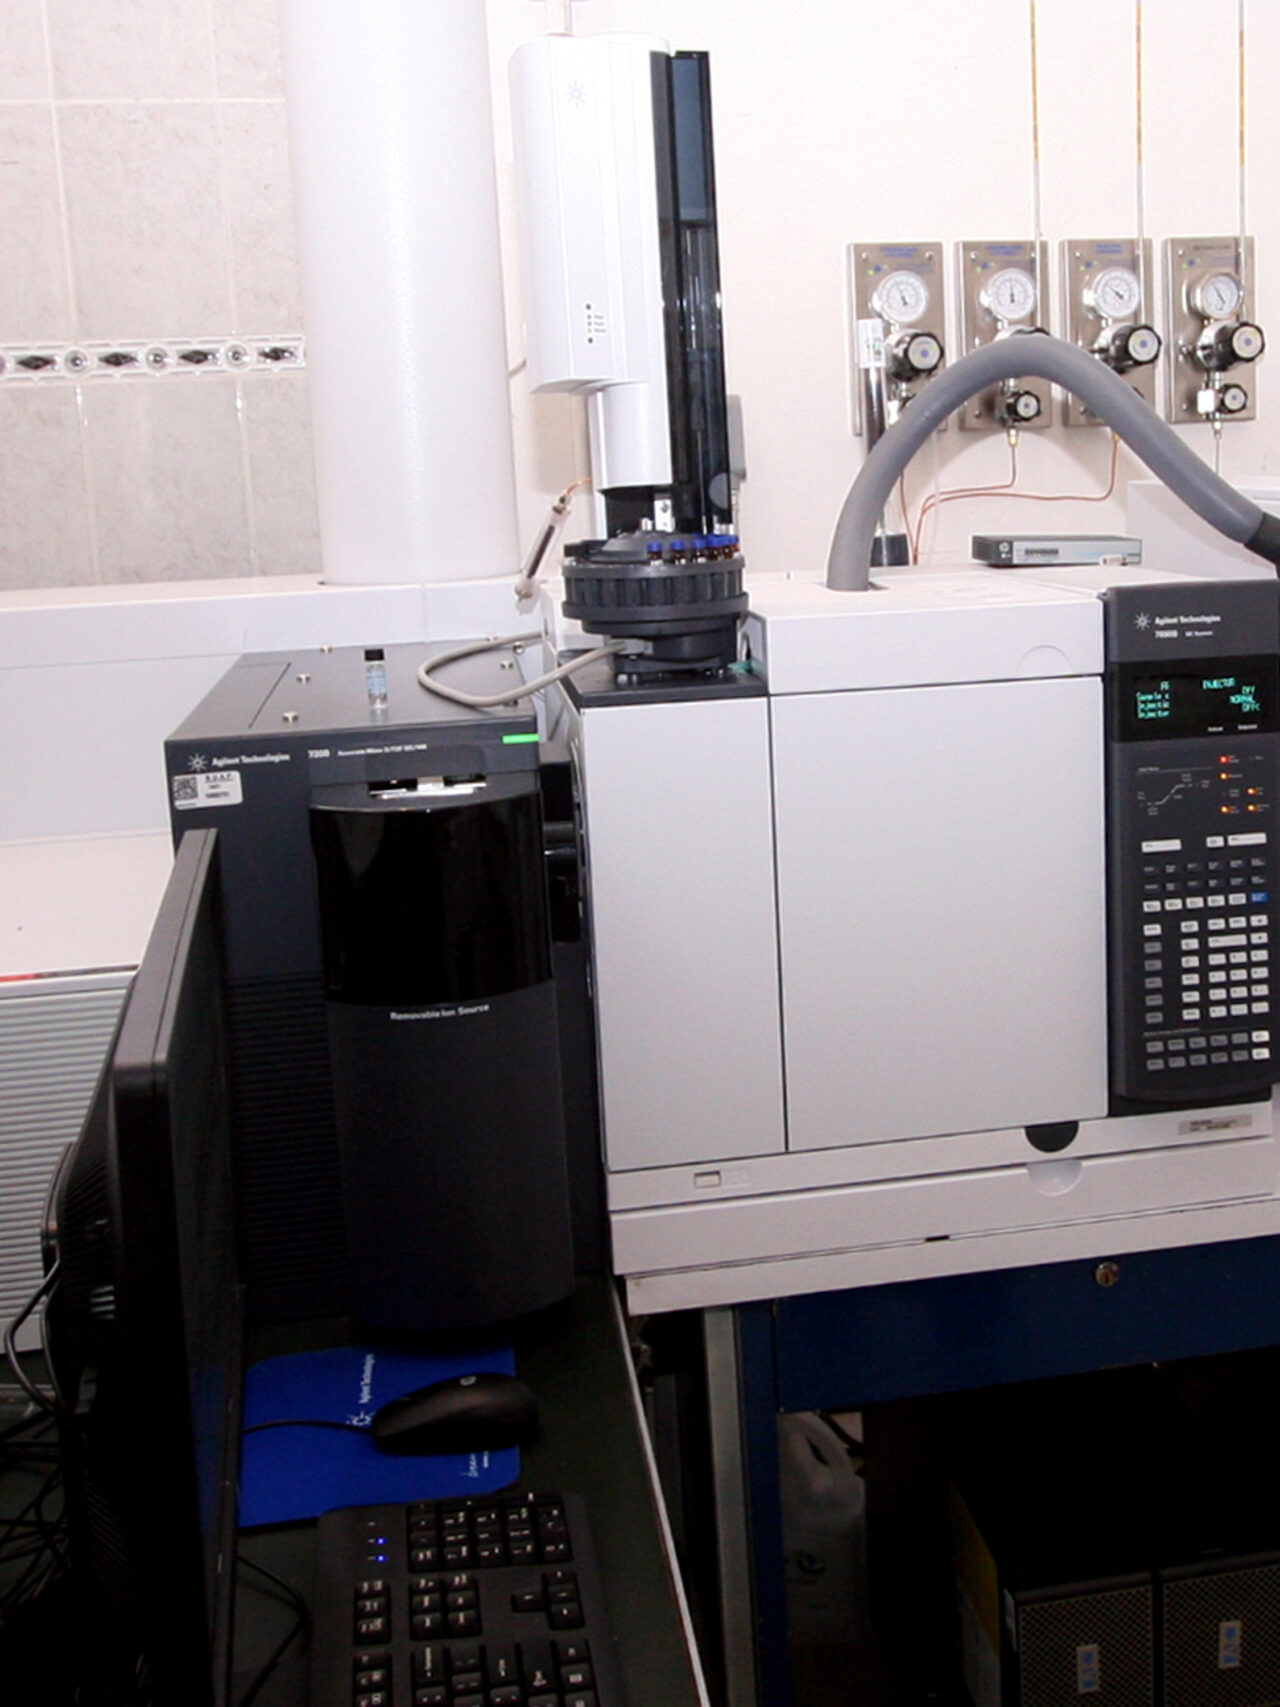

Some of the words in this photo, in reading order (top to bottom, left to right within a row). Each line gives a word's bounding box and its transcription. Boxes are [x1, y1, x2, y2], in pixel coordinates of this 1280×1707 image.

[1155, 616, 1178, 626] Agilent
[1180, 614, 1221, 624] Technologies
[211, 757, 239, 767] Agilent
[240, 753, 290, 764] Technologies
[390, 1010, 440, 1020] Removable
[441, 1009, 456, 1017] Ion
[458, 1003, 490, 1015] Source
